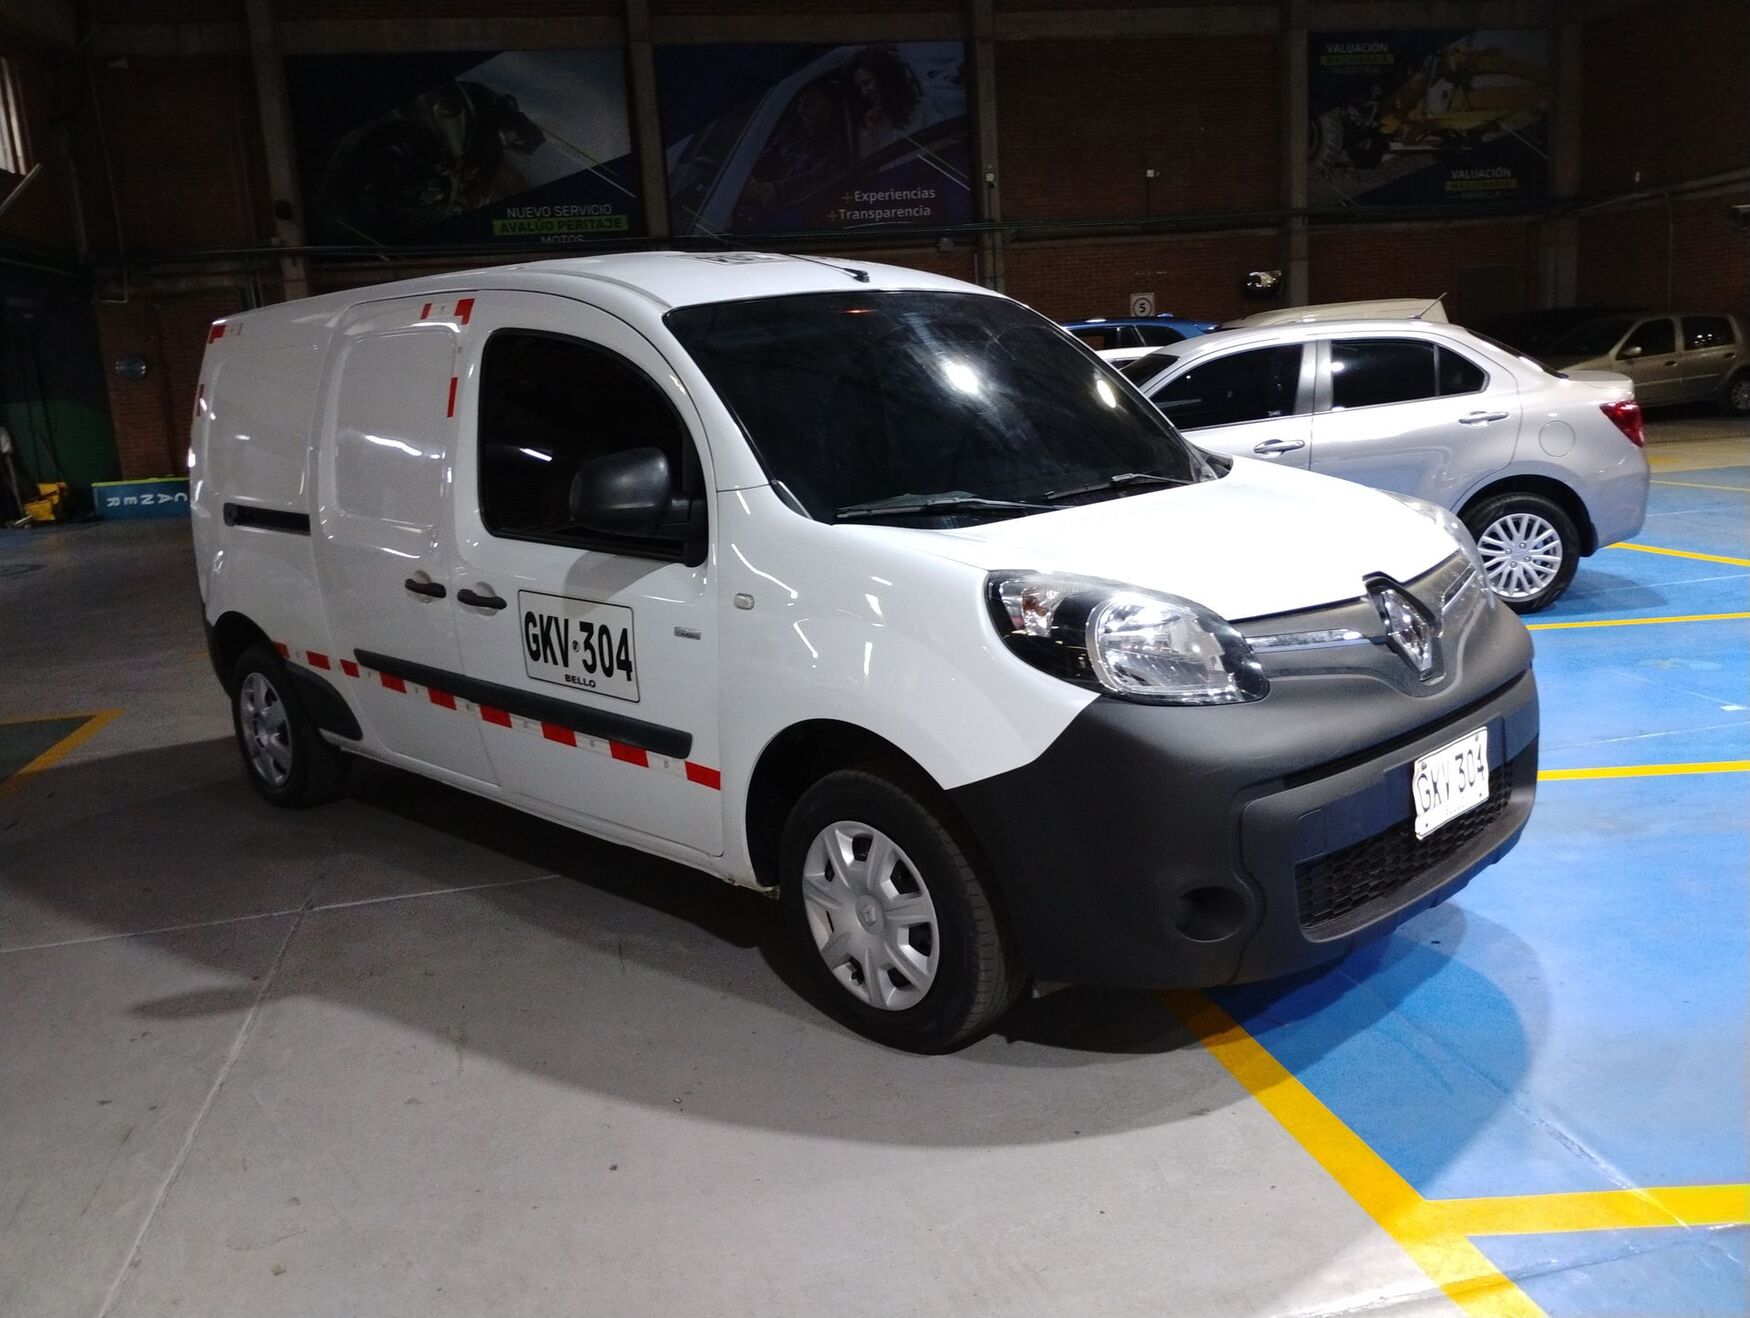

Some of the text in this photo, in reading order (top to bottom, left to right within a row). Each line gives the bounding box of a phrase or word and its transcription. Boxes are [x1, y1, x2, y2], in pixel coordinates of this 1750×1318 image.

[1450, 166, 1512, 179] VALUACIÓN
[507, 204, 612, 218] NUEVO SERVICIO
[500, 217, 624, 233] AVALÚO PERITAJE
[579, 620, 633, 681] 304
[564, 673, 596, 688] BELLO
